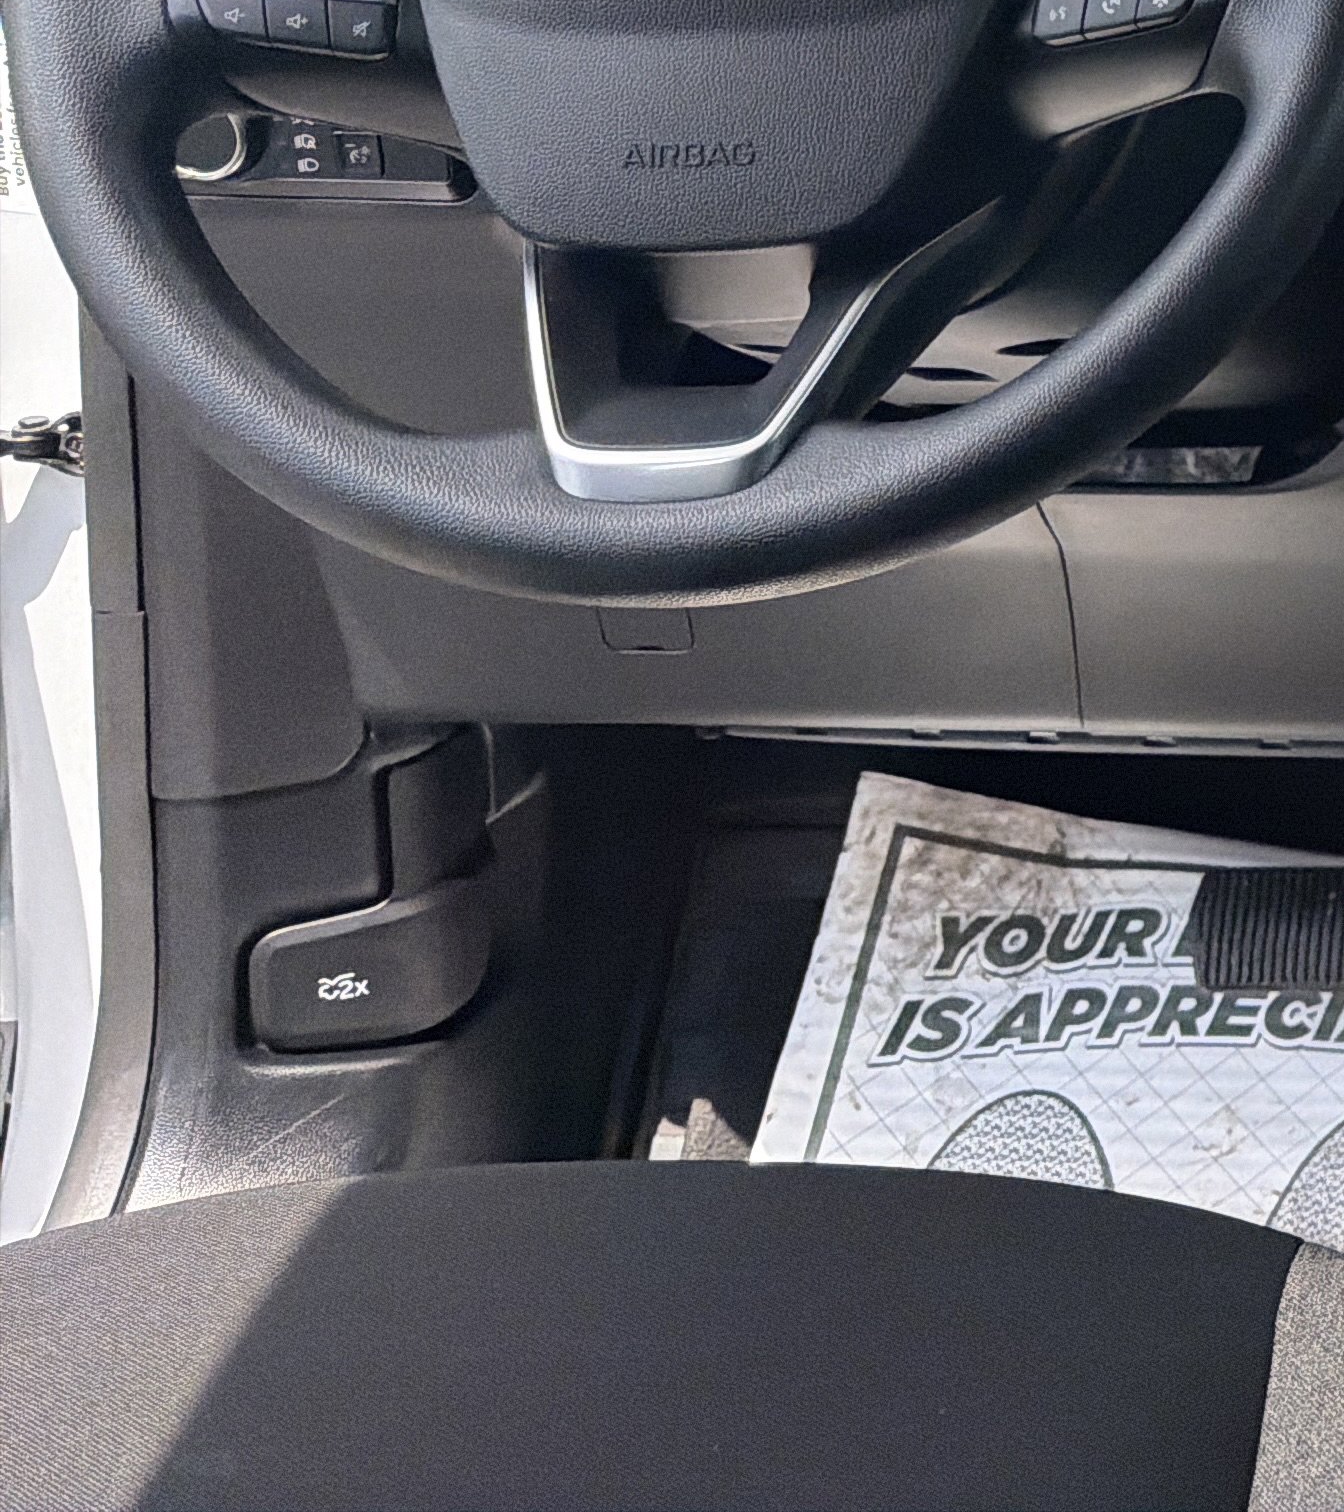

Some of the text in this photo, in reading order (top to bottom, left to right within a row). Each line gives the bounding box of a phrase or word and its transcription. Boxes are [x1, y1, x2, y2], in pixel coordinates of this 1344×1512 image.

[624, 142, 757, 169] AIRBAG
[930, 906, 1168, 974] YOUR
[874, 994, 980, 1062] IS
